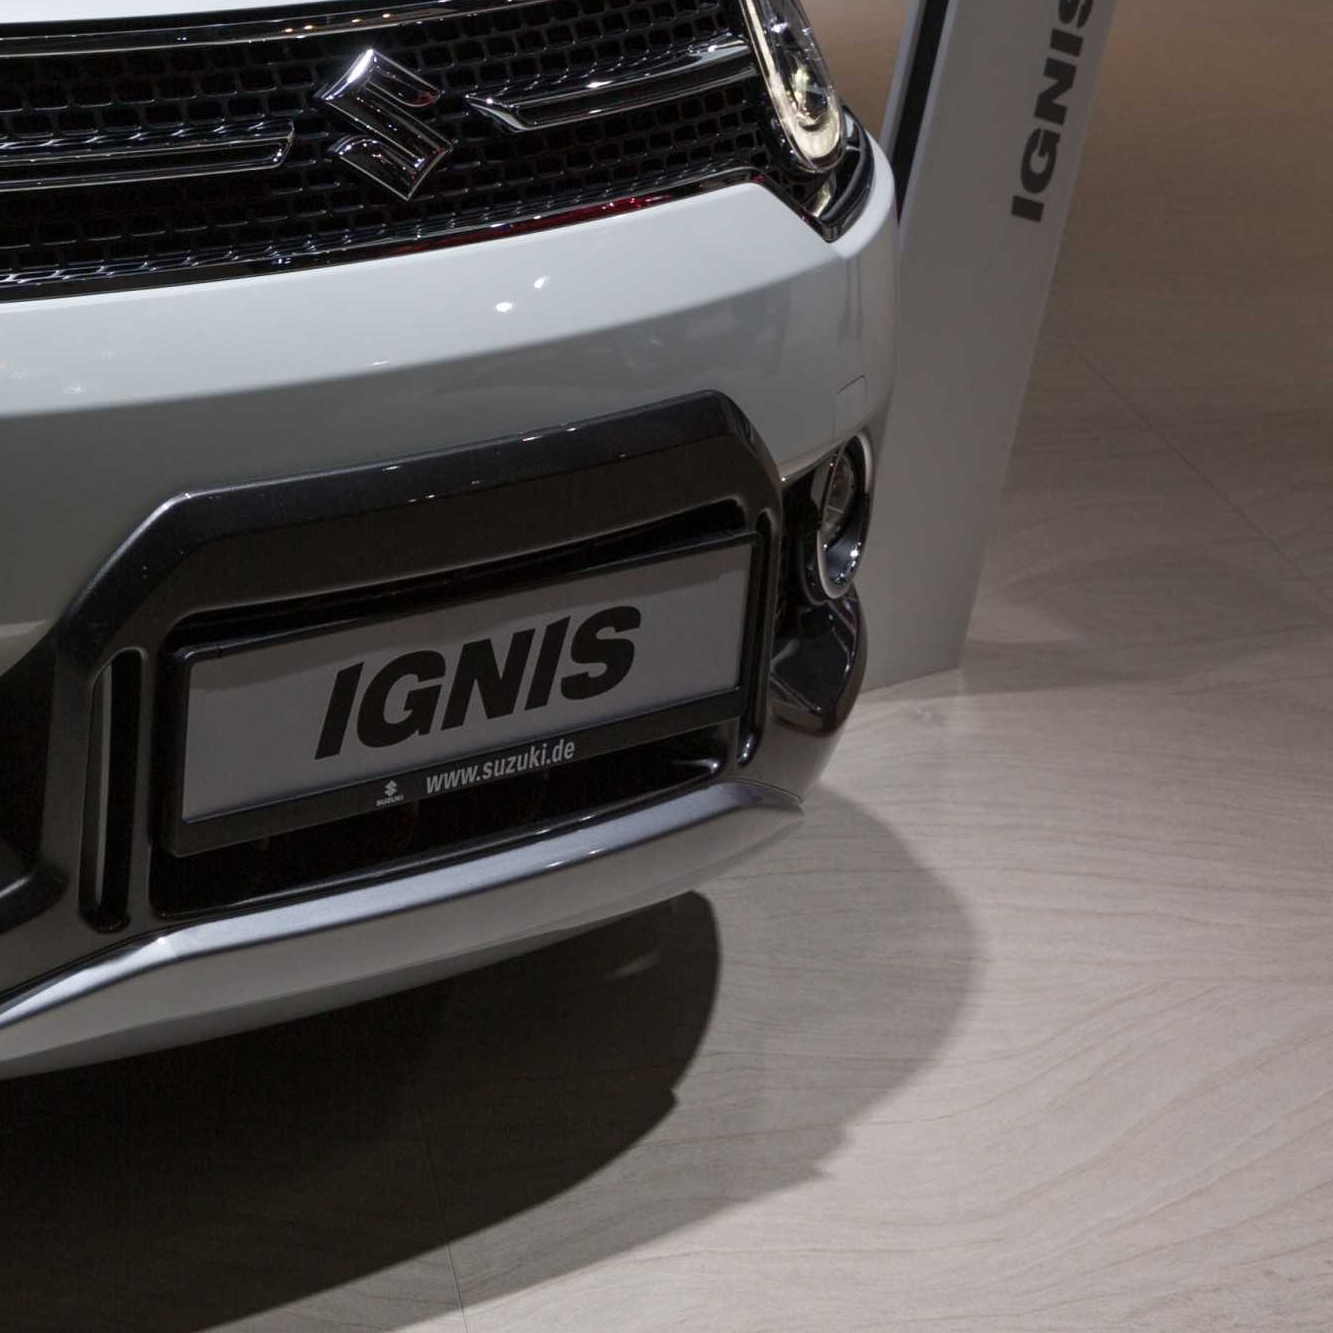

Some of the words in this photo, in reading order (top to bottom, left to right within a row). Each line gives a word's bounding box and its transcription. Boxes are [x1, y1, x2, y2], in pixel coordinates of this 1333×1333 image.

[314, 605, 642, 760] IGNIS
[426, 739, 576, 794] www.suzuki.de
[376, 793, 404, 806] SUZUKI
